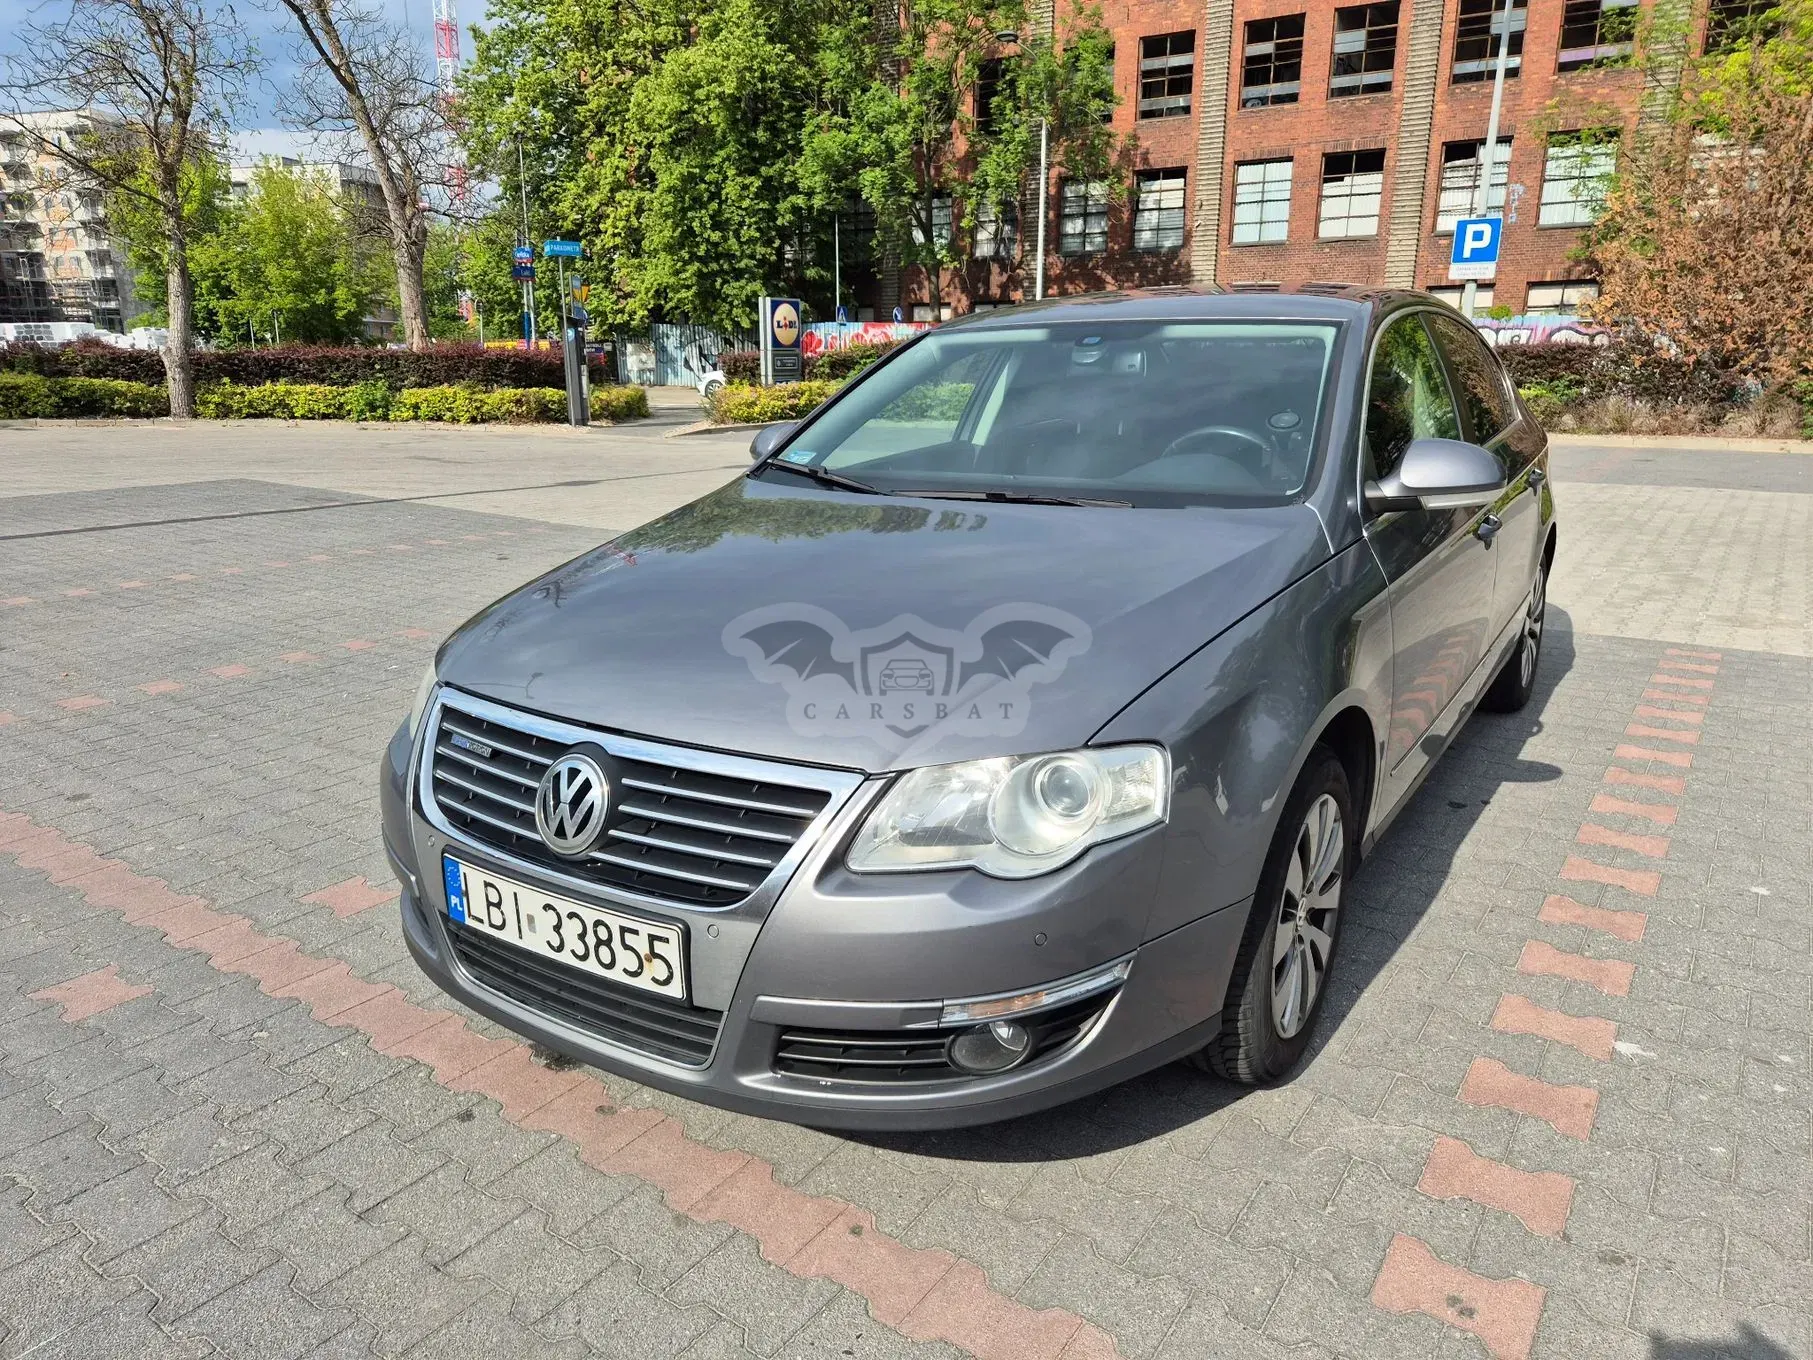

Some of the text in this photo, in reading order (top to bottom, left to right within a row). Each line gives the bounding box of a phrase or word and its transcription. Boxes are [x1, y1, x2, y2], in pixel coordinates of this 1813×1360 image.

[1462, 223, 1492, 259] P
[450, 894, 463, 912] PL
[463, 872, 674, 986] LBI 33855
